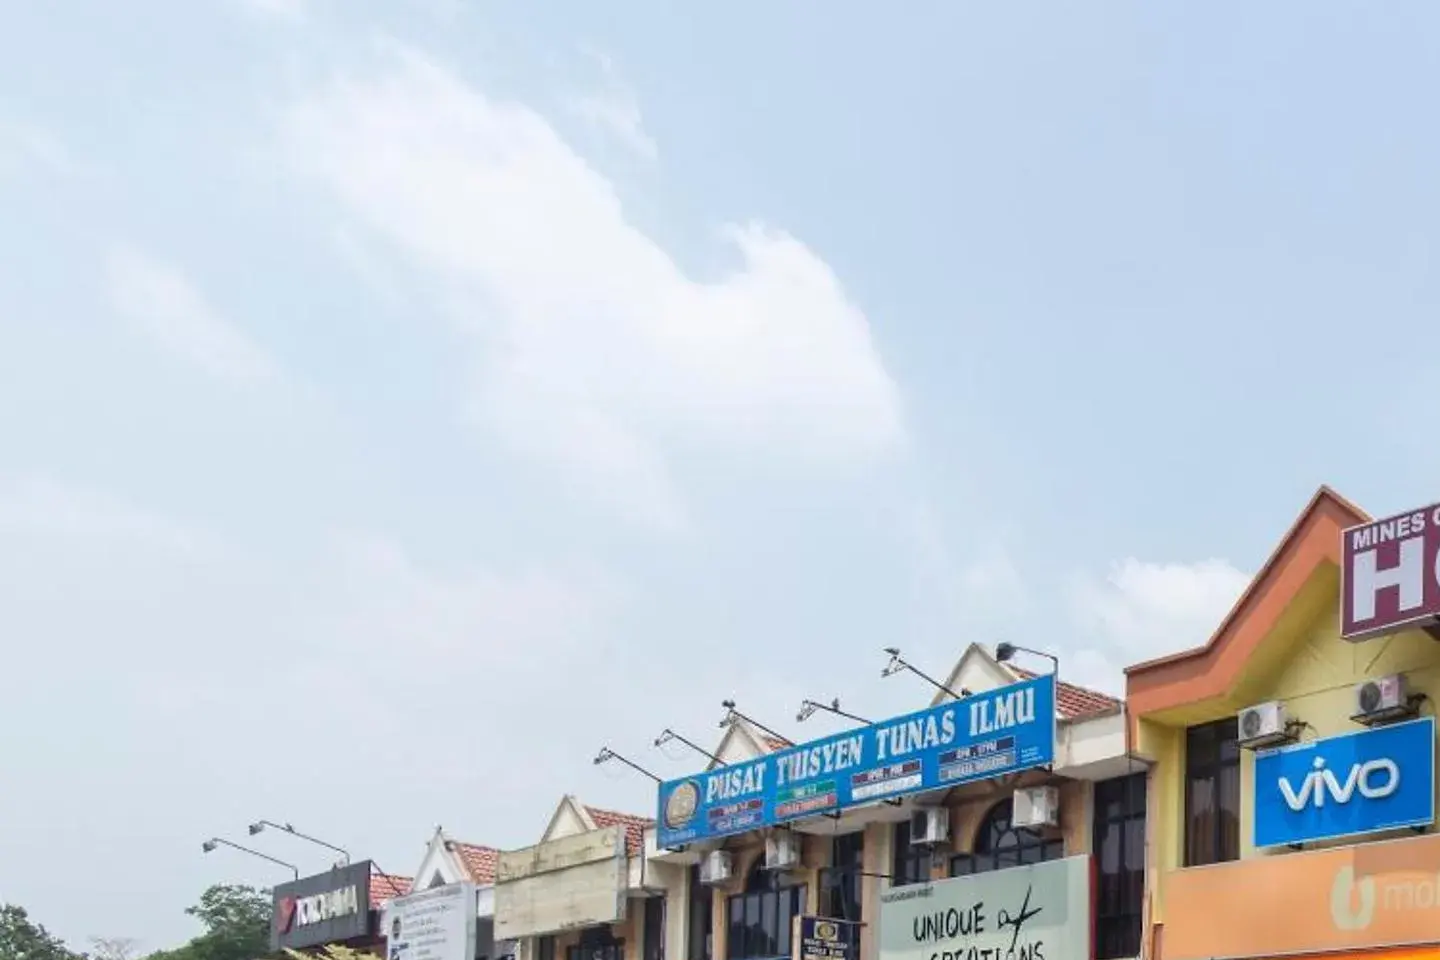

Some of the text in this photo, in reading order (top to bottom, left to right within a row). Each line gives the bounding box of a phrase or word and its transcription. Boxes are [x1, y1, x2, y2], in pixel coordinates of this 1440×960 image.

[1353, 513, 1425, 550] MINES
[706, 762, 767, 804] PUSAT
[876, 708, 955, 761] TUNAS
[968, 687, 1036, 737] ILMU
[1278, 756, 1399, 812] vivo
[913, 901, 986, 942] UNIQUE
